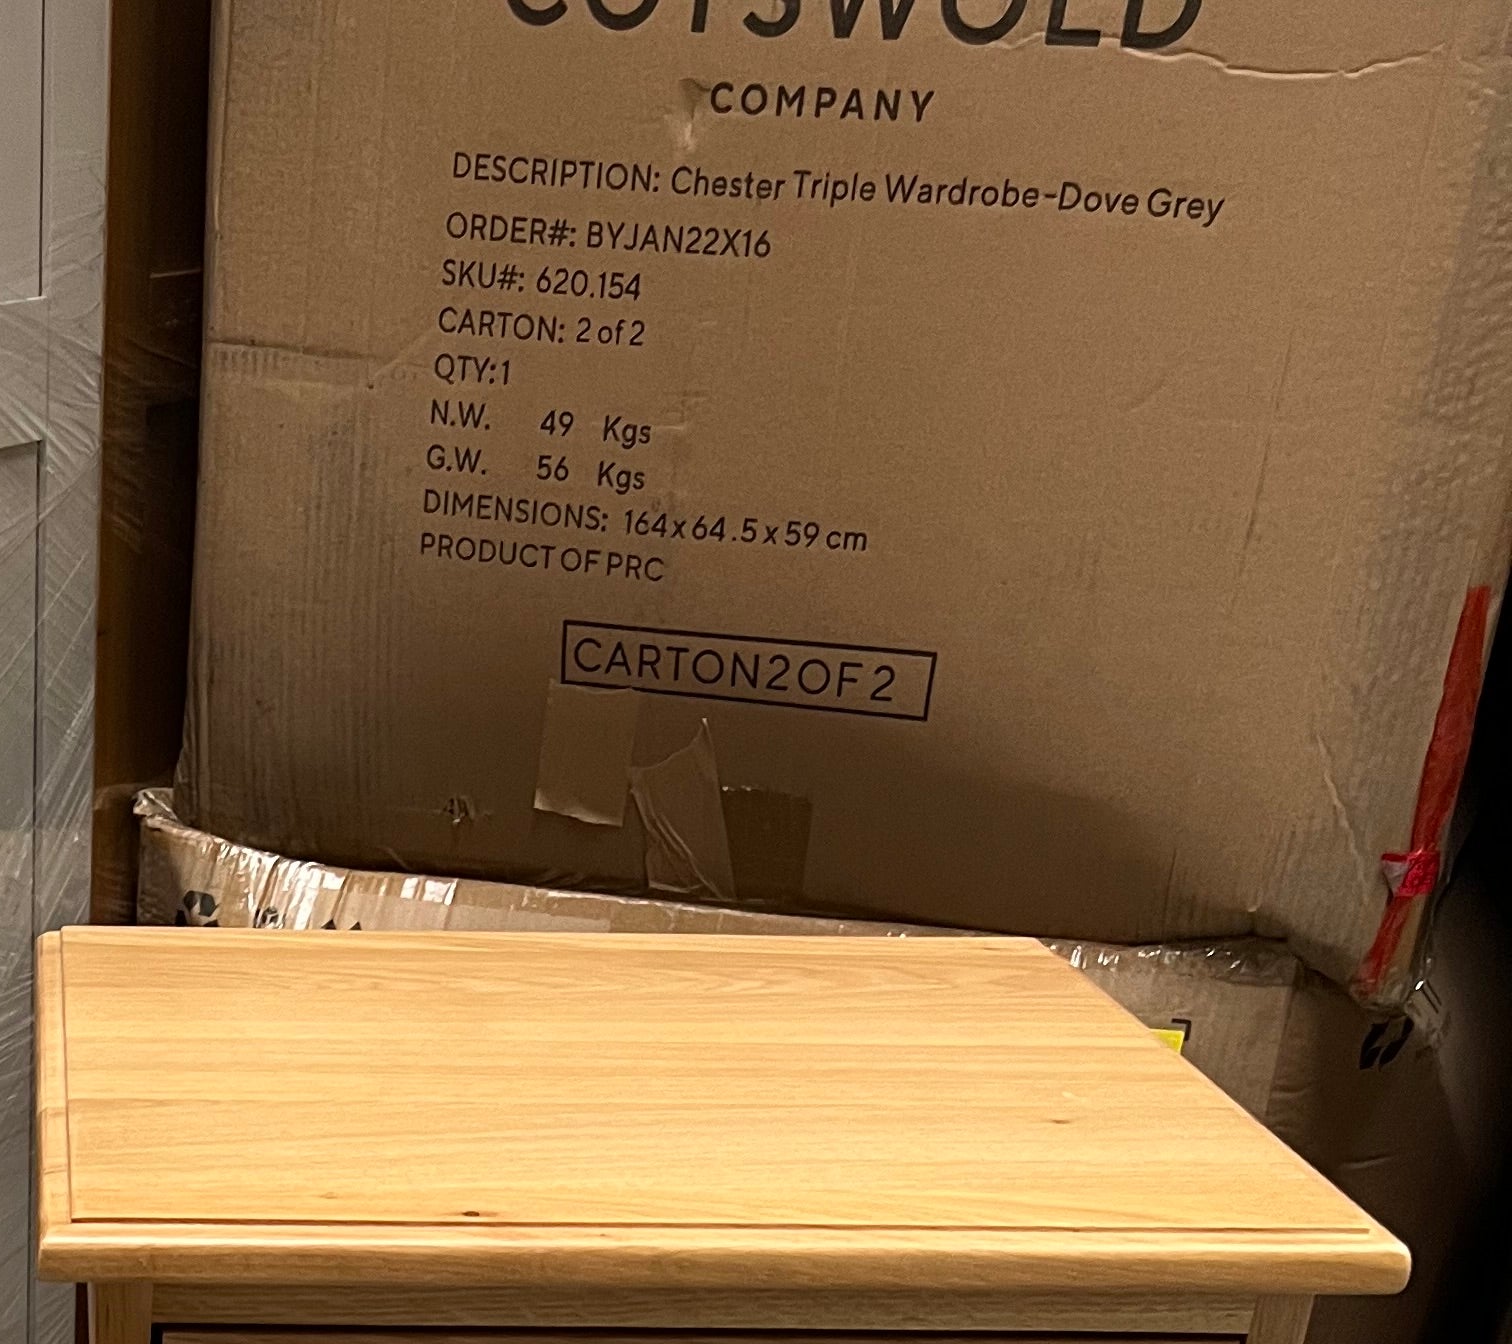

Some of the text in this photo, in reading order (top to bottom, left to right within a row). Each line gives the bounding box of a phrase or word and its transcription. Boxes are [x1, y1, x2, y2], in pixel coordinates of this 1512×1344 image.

[710, 81, 935, 123] COMPANY
[452, 151, 661, 193] DESCRIPTION:
[671, 165, 786, 202] Chester
[792, 169, 877, 209] Triple
[1147, 187, 1226, 228] Grey
[445, 211, 772, 260] ORDER#: BYJAN22X16
[440, 258, 642, 302] SKU#: 620.154
[437, 306, 646, 347] CARTON: 2 of 2
[429, 398, 653, 450] N.W. 49 Kgs
[425, 443, 646, 496] G.W. 56 Kgs
[422, 487, 609, 532] DIMENSIONS:
